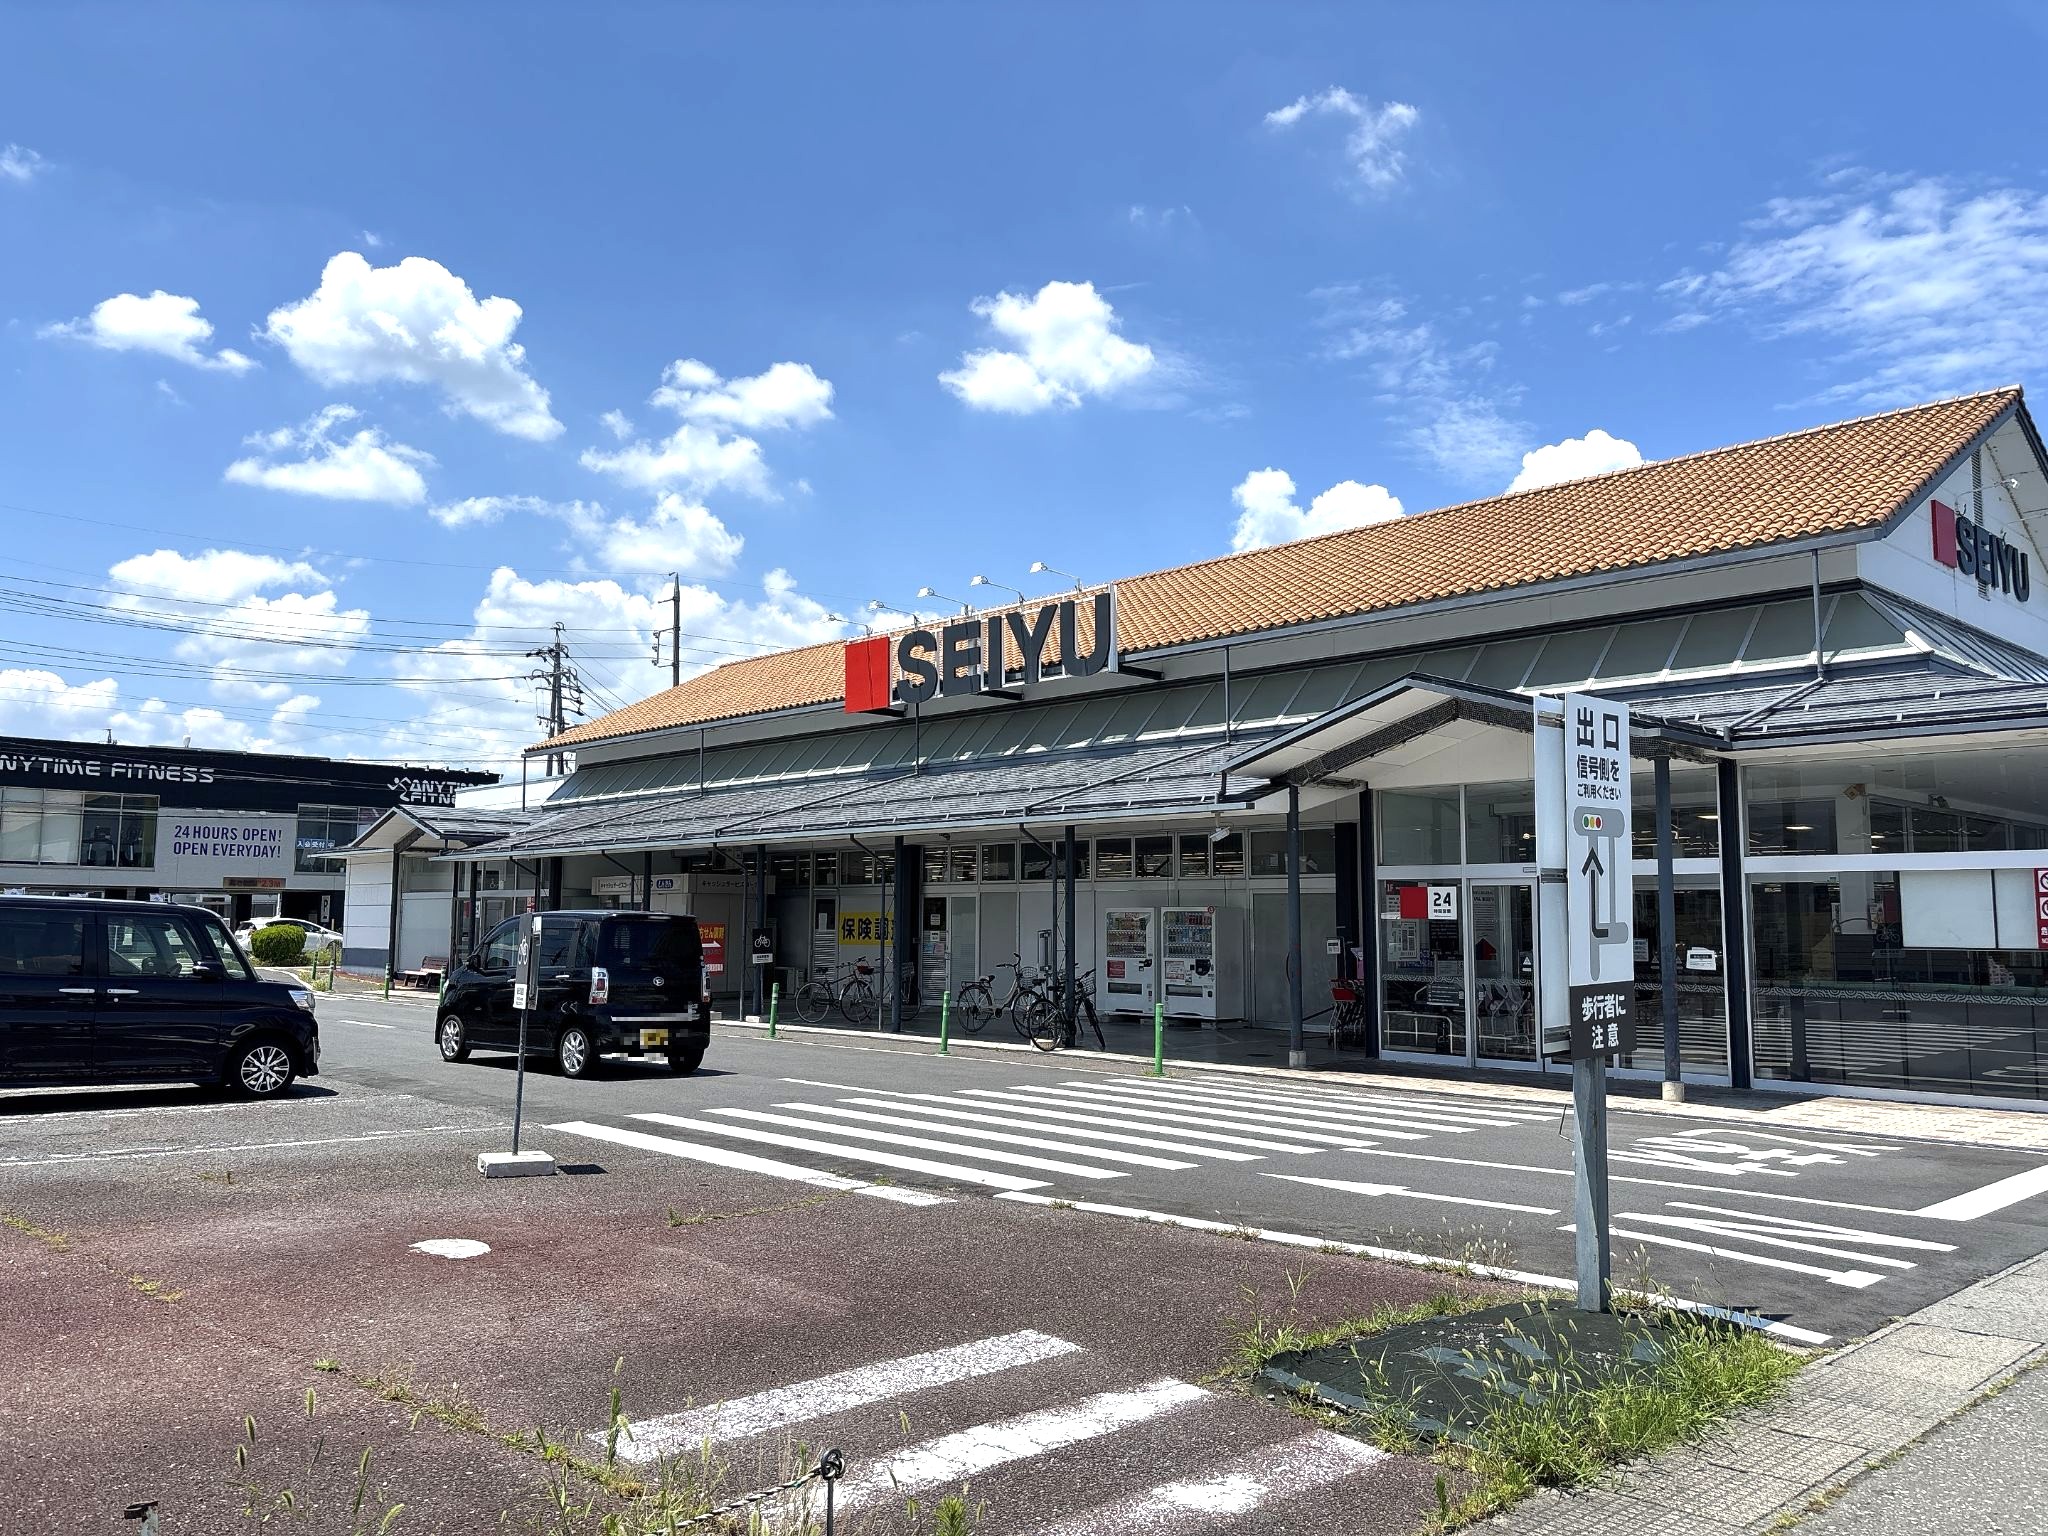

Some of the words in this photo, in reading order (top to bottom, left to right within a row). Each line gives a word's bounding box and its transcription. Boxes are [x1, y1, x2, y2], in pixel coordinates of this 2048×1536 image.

[1956, 516, 2030, 603] SEIYU
[897, 593, 1110, 704] SEIYU
[1576, 706, 1620, 752] 出口
[110, 762, 215, 784] FITNESS
[1576, 754, 1620, 782] 信号側を
[1577, 783, 1622, 801] ご利用ください
[174, 825, 190, 839] 24
[192, 826, 238, 841] HOURS
[242, 828, 282, 843] OPEN!
[296, 840, 335, 849] 入会受付中
[173, 841, 208, 856] OPEN
[212, 843, 281, 858] EVERYDAY!
[1433, 892, 1452, 907] 24
[1582, 993, 1627, 1022] 歩行者に
[1591, 1022, 1620, 1050] 注意
